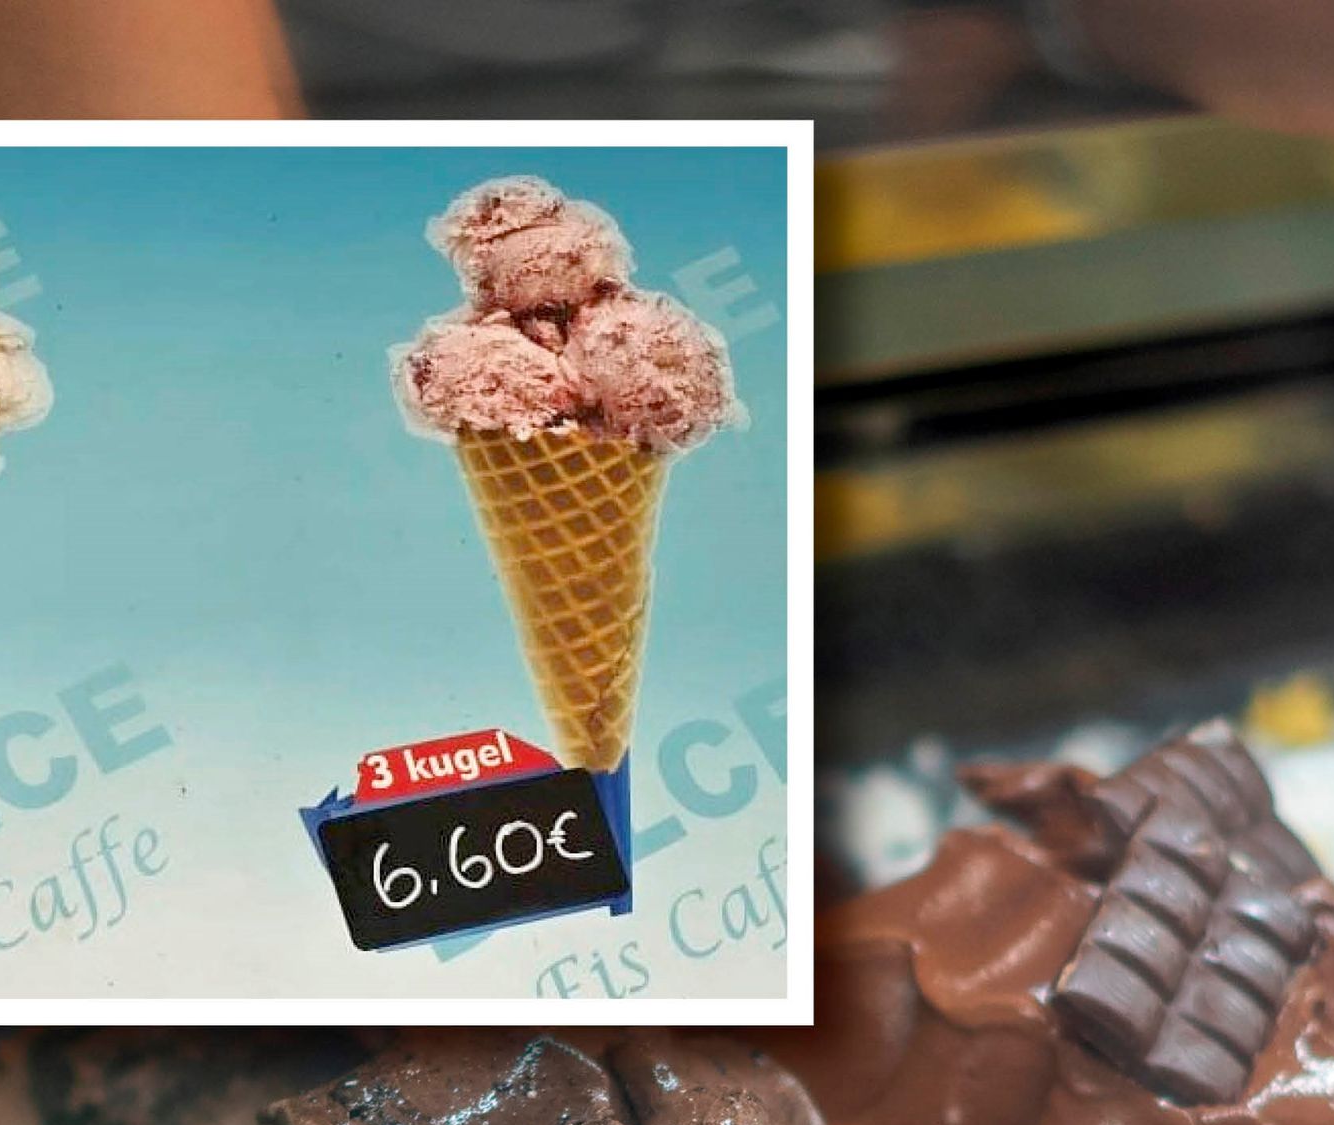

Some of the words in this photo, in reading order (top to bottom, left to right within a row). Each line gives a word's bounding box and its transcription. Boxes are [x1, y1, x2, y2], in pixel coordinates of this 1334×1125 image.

[367, 754, 395, 790] 3
[403, 729, 514, 782] kugel
[669, 837, 787, 958] Caf
